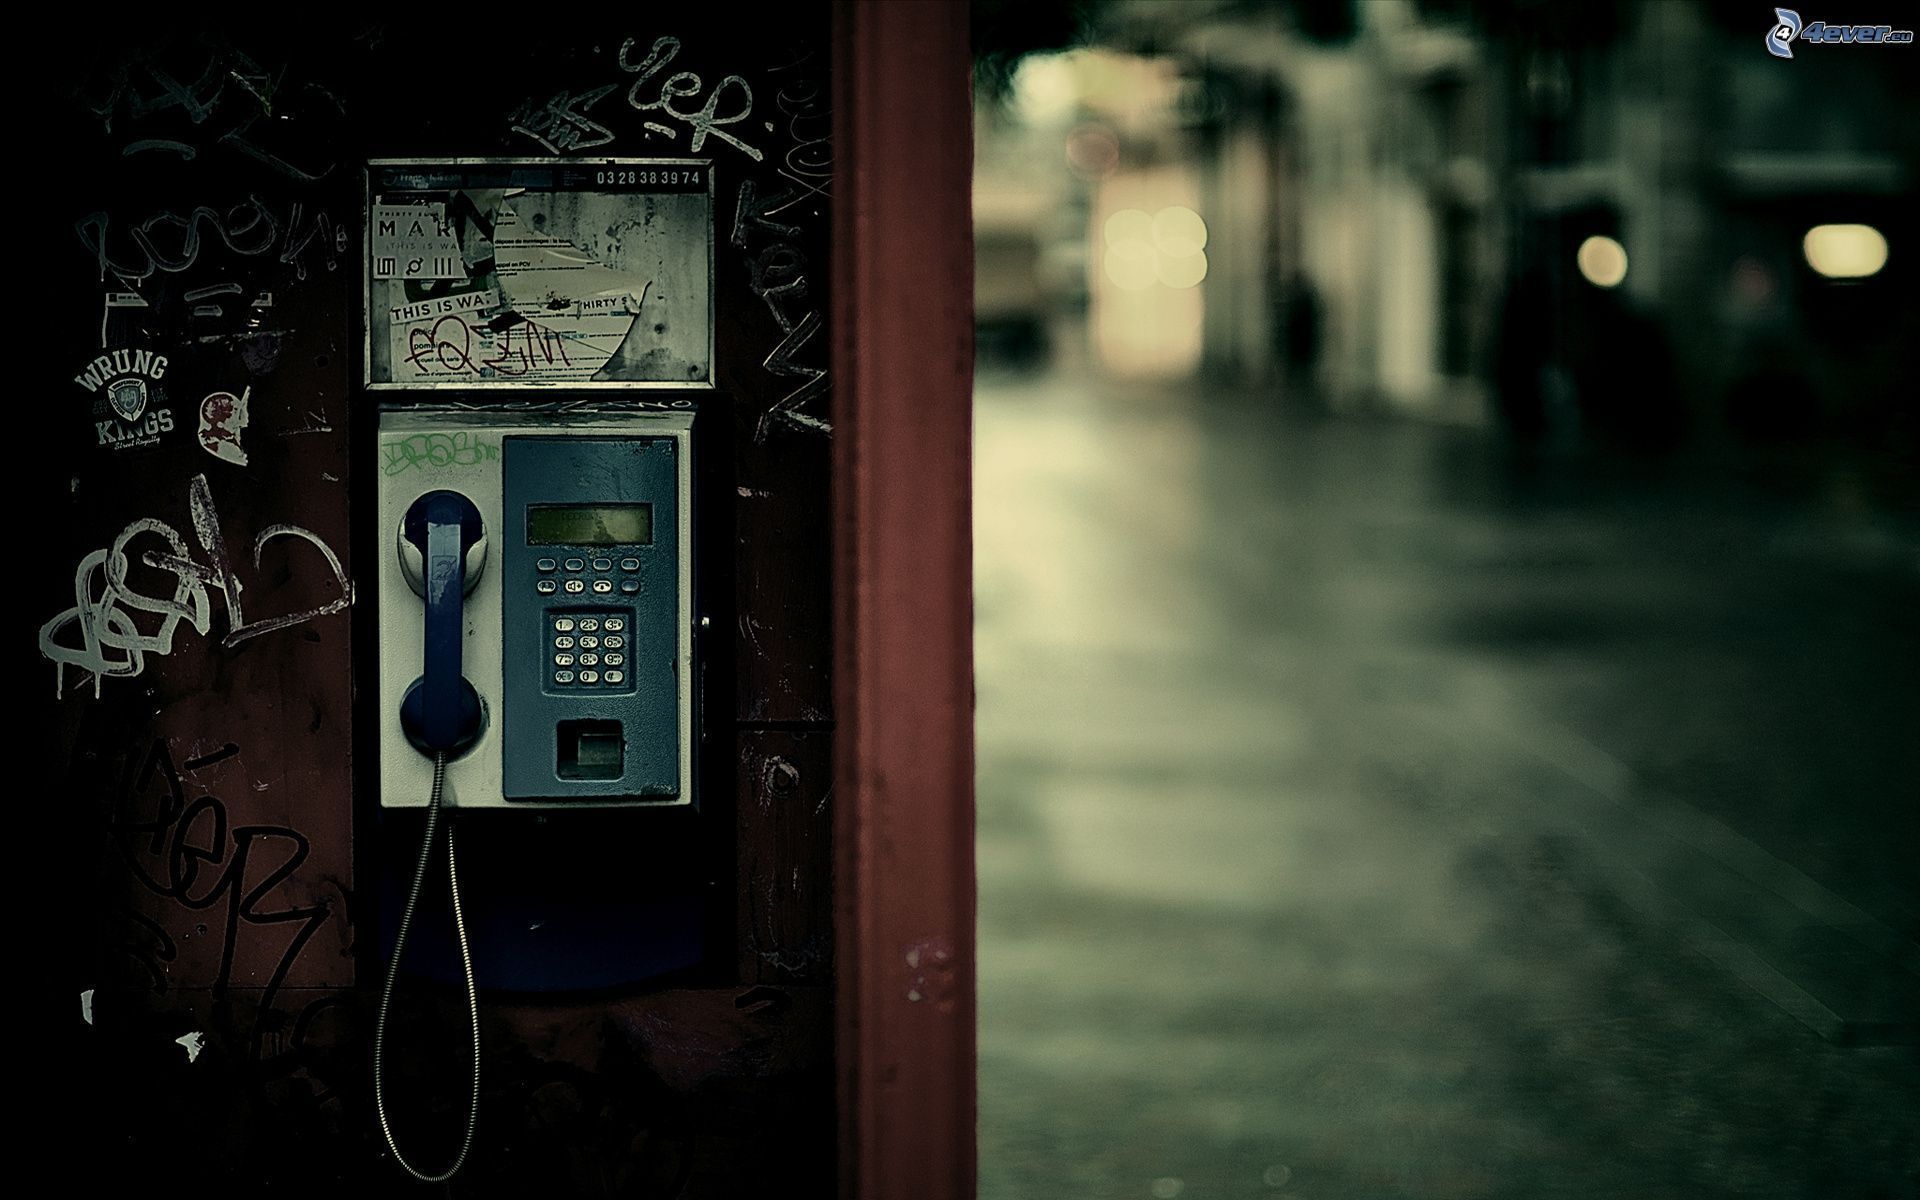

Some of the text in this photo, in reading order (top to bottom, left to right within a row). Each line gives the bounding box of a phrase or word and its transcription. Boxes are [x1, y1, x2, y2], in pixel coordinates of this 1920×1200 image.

[392, 304, 431, 320] THIS
[438, 300, 453, 313] IS
[456, 293, 492, 309] WA
[580, 297, 617, 310] HIRTY
[74, 349, 168, 392] WRUNG
[95, 408, 174, 445] KINGS
